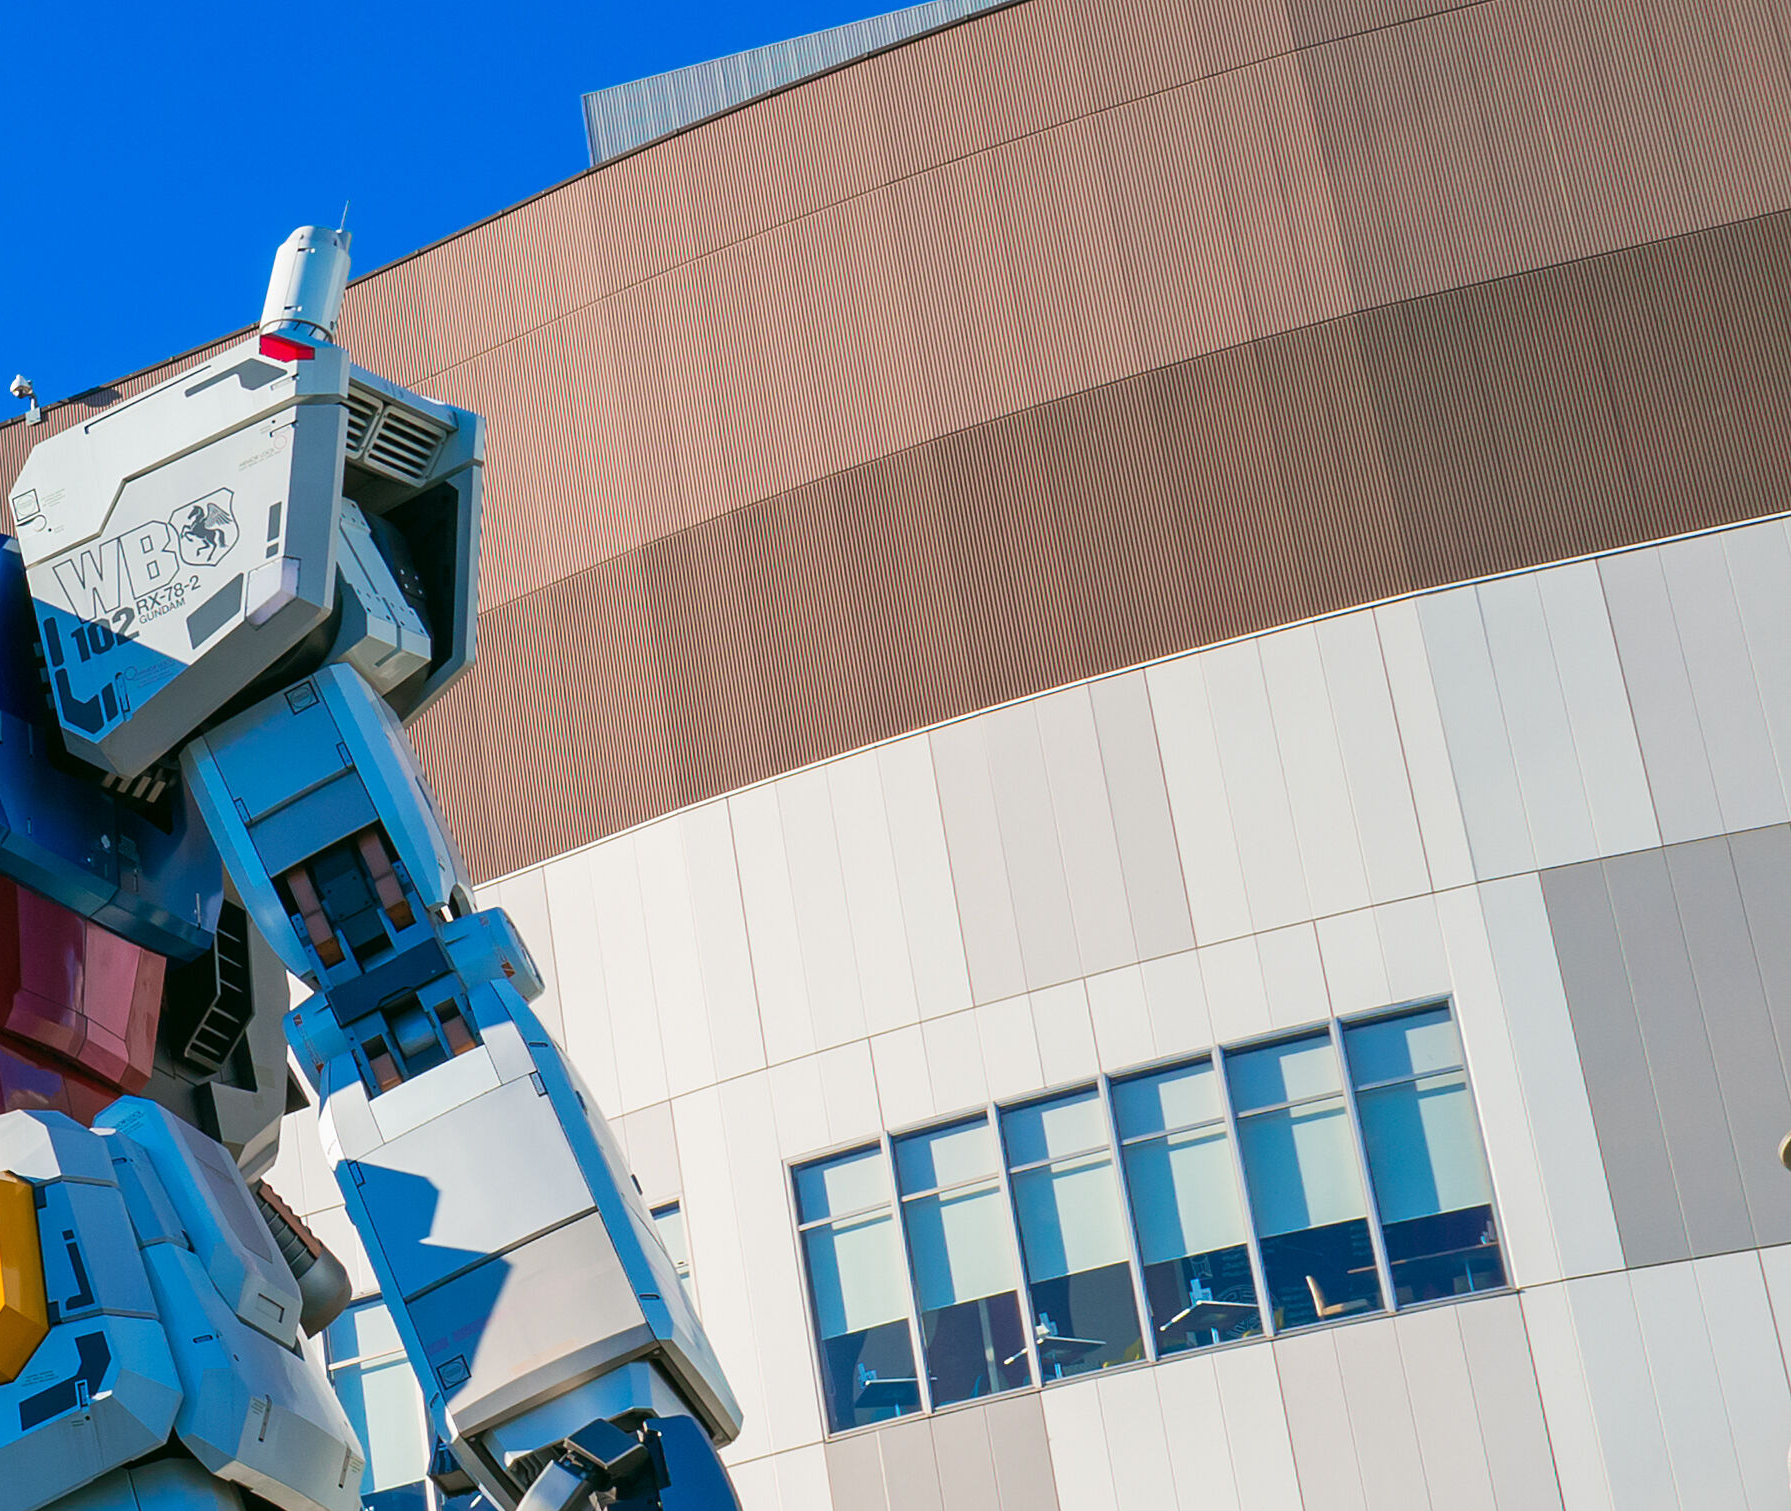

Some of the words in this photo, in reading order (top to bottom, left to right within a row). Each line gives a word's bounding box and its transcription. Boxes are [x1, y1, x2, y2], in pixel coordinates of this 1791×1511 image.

[52, 520, 180, 624] WB
[136, 574, 201, 615] RX-78-2
[71, 606, 140, 663] 102
[139, 597, 186, 625] GUNDAM
